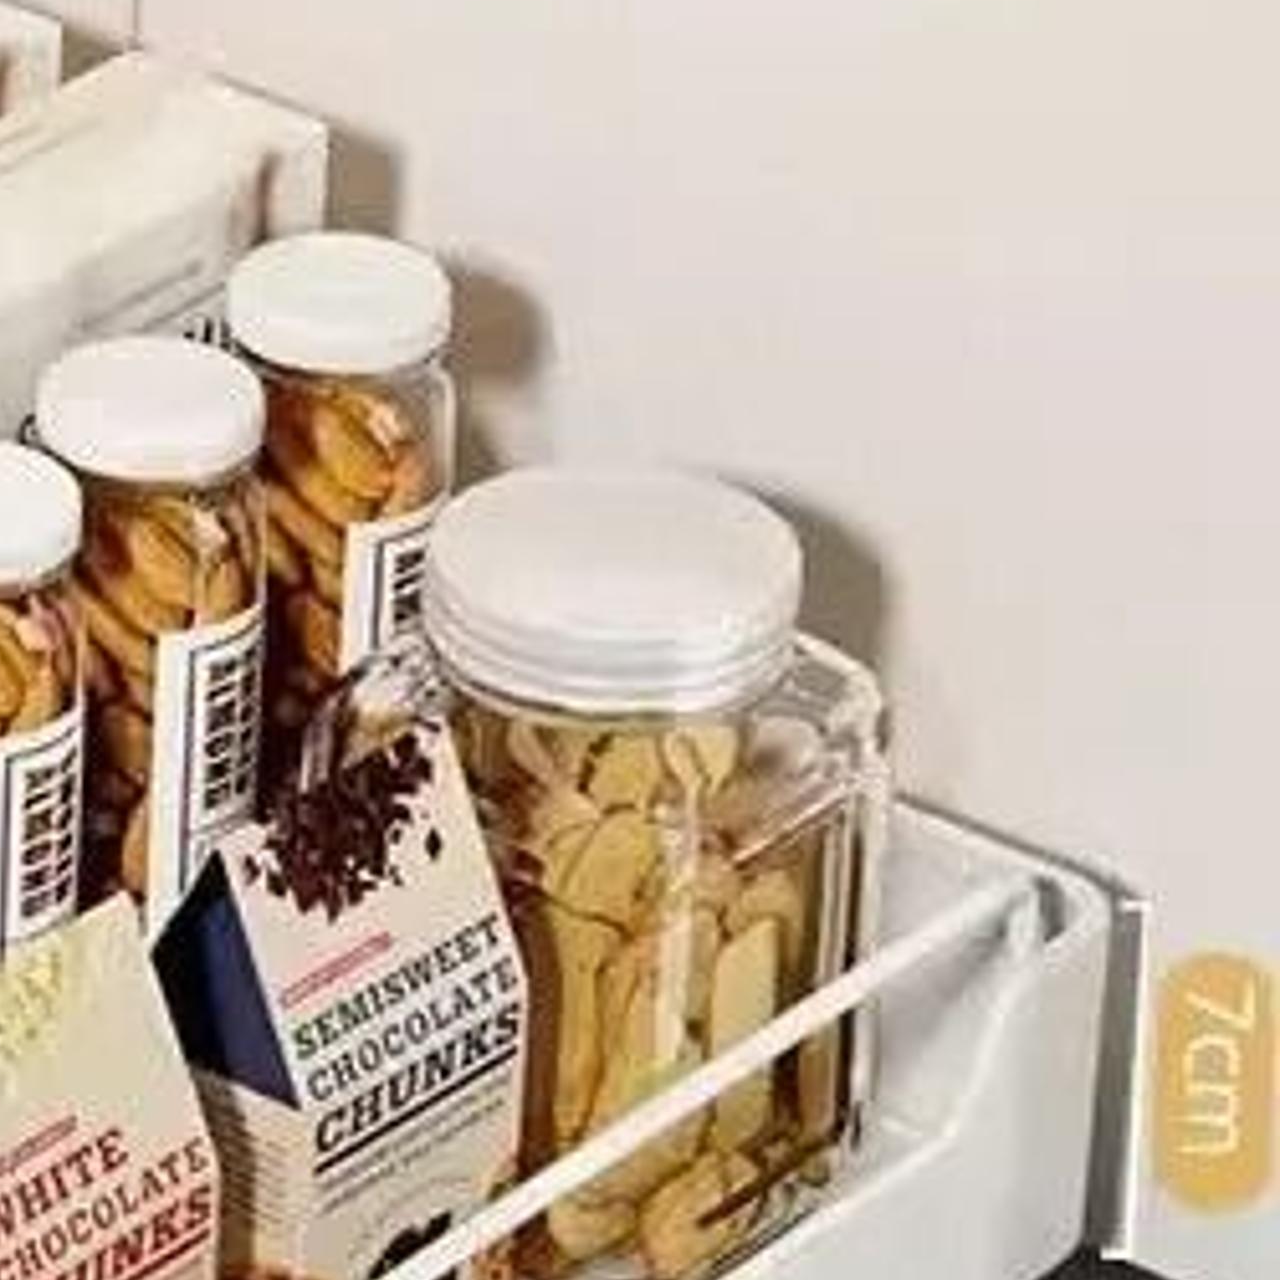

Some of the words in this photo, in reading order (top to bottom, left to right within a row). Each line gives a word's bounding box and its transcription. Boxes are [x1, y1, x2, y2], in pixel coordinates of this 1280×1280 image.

[294, 912, 498, 1060] SEMISWEET
[306, 955, 518, 1102] CHOCOLATE
[316, 1002, 520, 1152] CHUNKS
